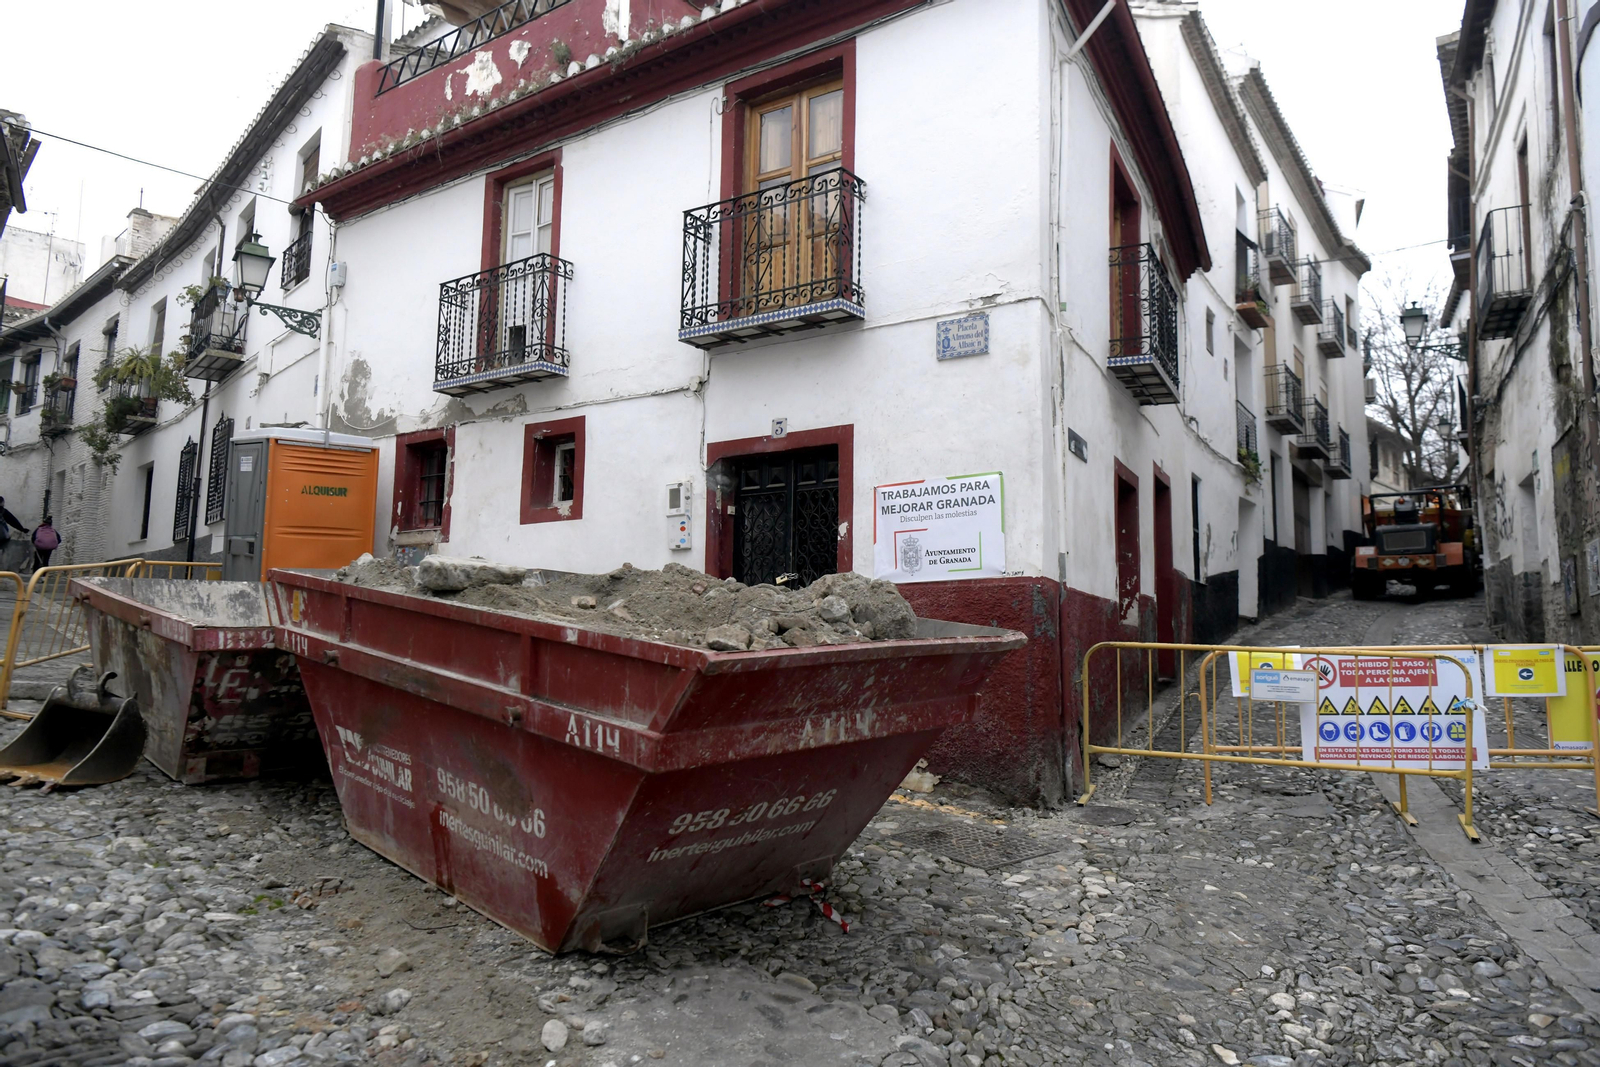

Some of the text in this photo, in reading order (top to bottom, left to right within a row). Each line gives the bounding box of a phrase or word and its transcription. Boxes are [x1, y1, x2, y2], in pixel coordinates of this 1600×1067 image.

[974, 329, 984, 339] del
[958, 339, 982, 349] Albaicn
[774, 421, 784, 436] 3
[301, 485, 348, 497] ALQUISUR
[881, 479, 991, 501] TRABAJAMOS PARA
[881, 494, 996, 516] MEJORAR GRANADA
[900, 509, 978, 523] Disculpen las molestias
[924, 547, 976, 557] AYUNTAMIENTO
[928, 556, 972, 566] DE GRANADA
[283, 629, 308, 657] A114
[1402, 660, 1425, 668] PASO
[565, 712, 621, 758] A114
[468, 781, 490, 815] 50
[668, 808, 731, 835] 958
[766, 795, 805, 819] 66
[802, 788, 838, 812] 66
